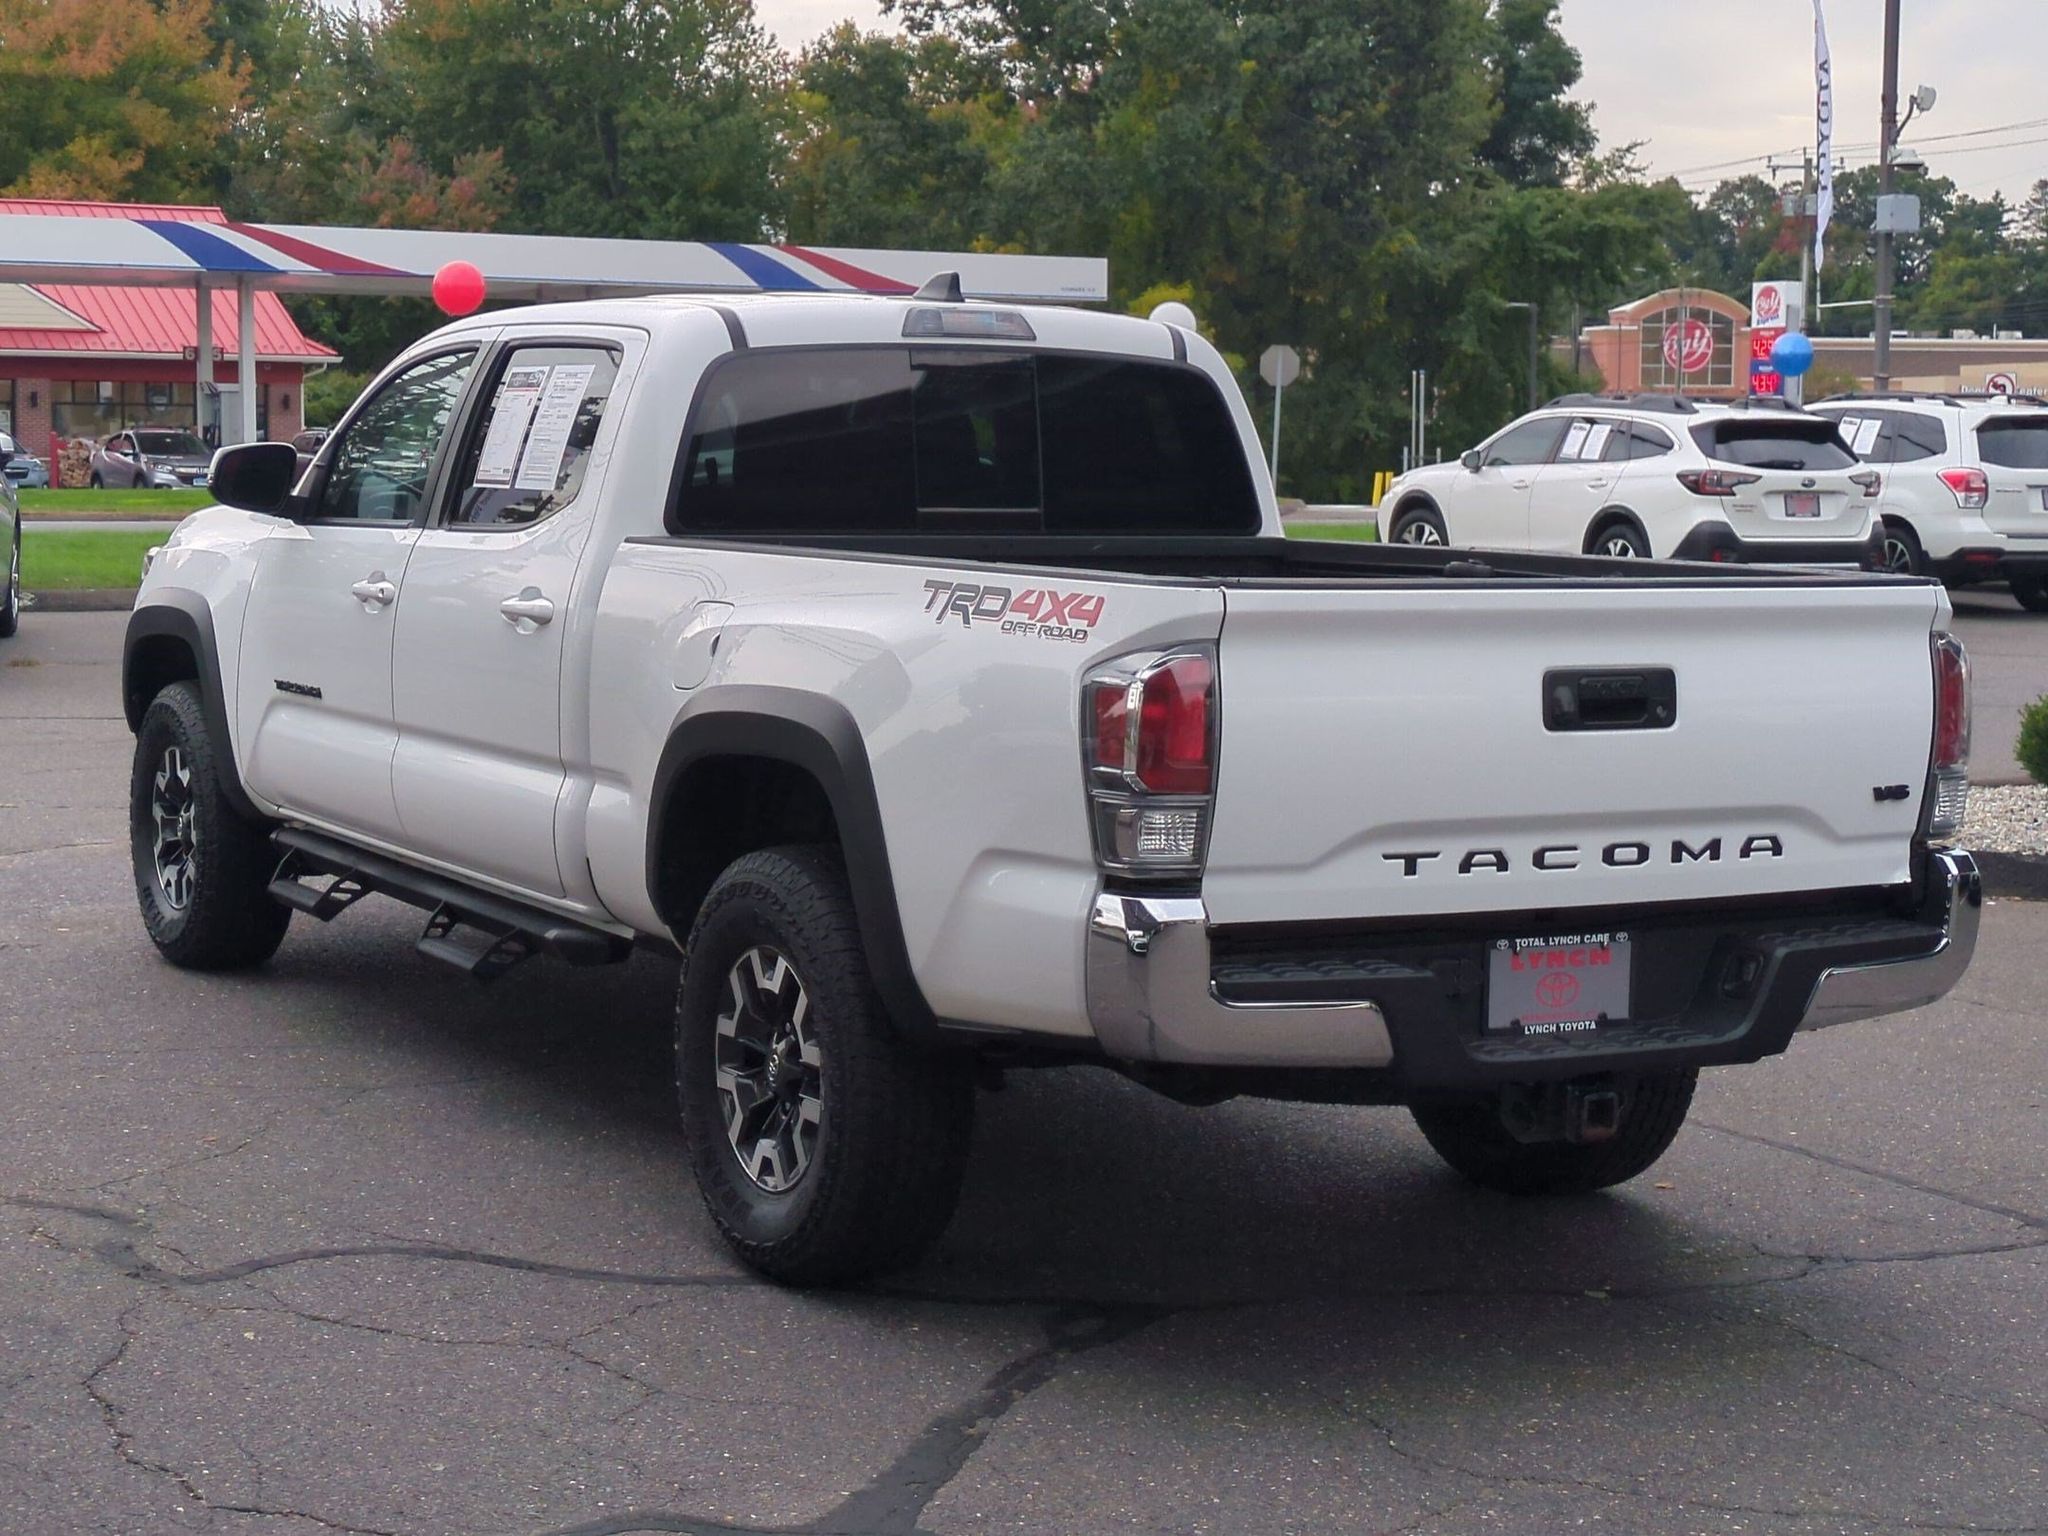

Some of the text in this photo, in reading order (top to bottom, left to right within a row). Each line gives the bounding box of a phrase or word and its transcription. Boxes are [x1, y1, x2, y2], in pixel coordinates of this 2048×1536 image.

[185, 347, 196, 360] 6
[923, 579, 1105, 629] TRD 4X4
[1001, 620, 1089, 643] OFF ROAD
[1872, 784, 1910, 802] V6
[1381, 834, 1784, 878] TACOMA
[1515, 933, 1610, 949] TOTAL LYNCH CARE
[1510, 946, 1613, 972] LYNCH
[1524, 1020, 1597, 1035] LYNCH TOYOTA
